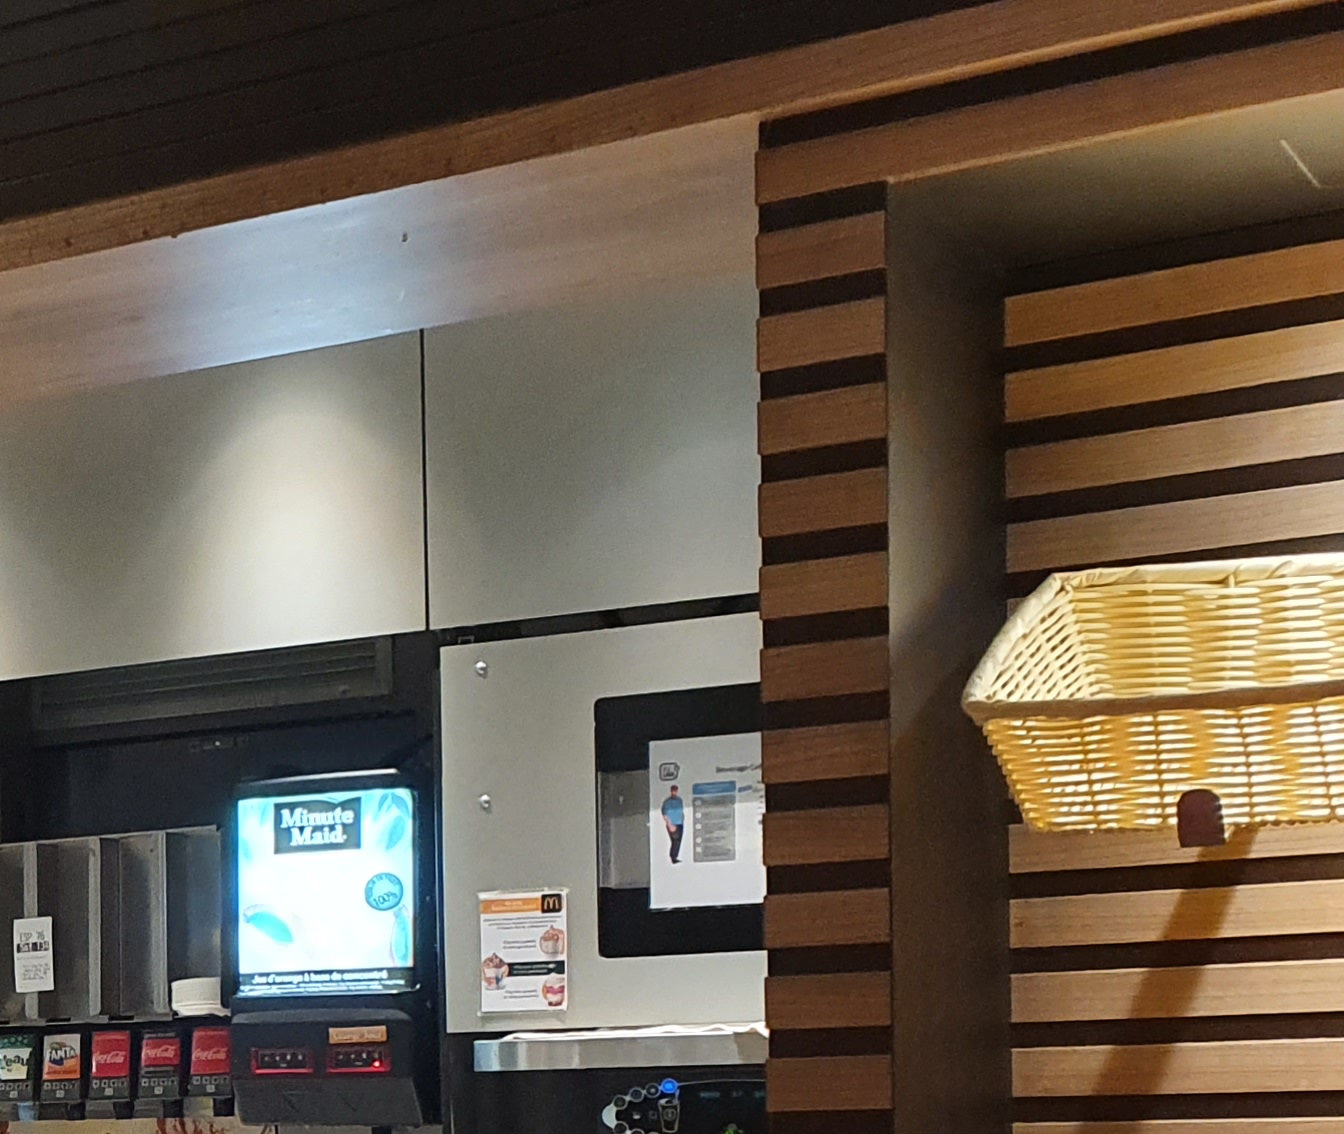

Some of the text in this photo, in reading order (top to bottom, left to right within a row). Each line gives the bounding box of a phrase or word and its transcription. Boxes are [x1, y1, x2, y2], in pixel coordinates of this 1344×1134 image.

[280, 807, 354, 828] Minute
[290, 825, 346, 846] Maid
[47, 1047, 77, 1061] FANTA
